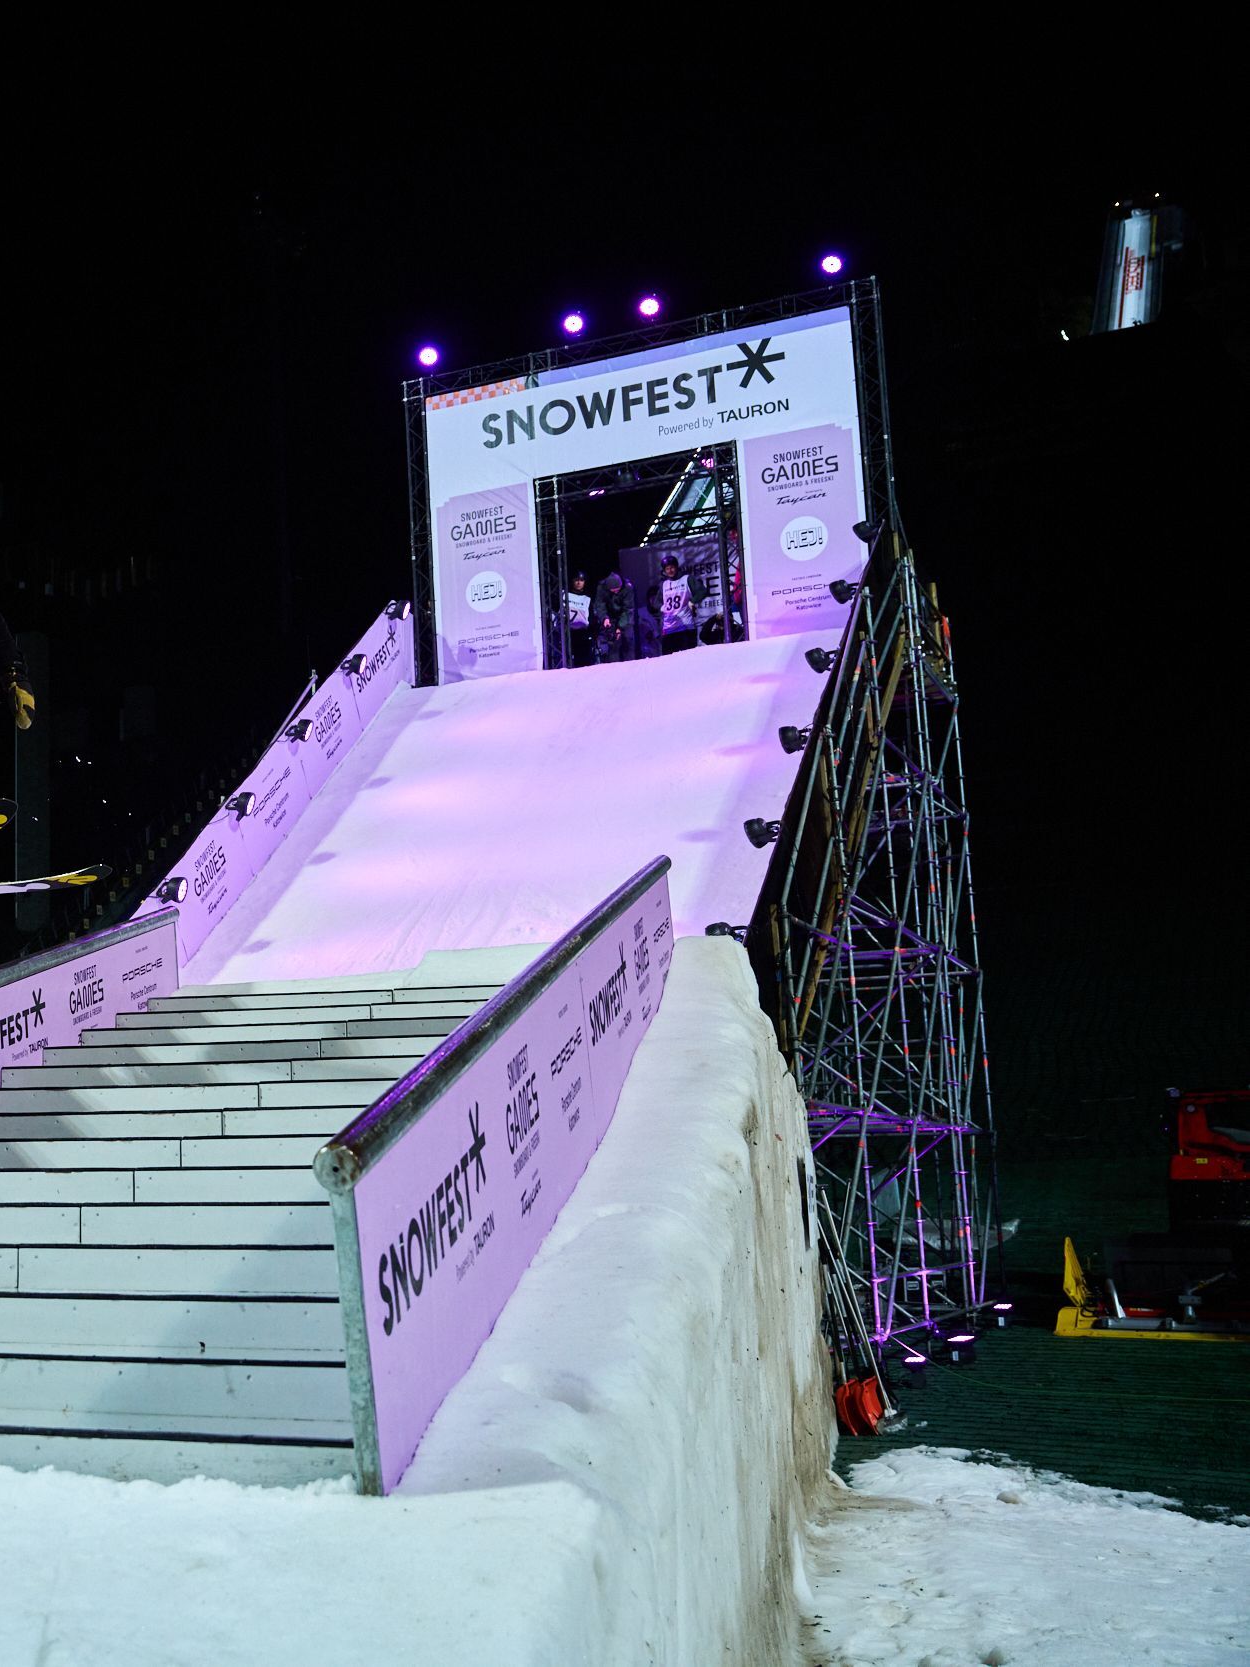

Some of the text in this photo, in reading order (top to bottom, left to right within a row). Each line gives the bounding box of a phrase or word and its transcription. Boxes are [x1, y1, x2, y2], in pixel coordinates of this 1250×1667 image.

[482, 364, 722, 449] SNOWFEST
[658, 398, 789, 437] Powered by TAURON
[773, 445, 824, 464] SNOWFEST
[761, 455, 839, 485] GAMES
[460, 505, 504, 522] SNOWFEST
[776, 492, 827, 506] Taycan
[450, 514, 516, 541] GAMES
[785, 526, 824, 550] HEJ!
[666, 595, 681, 611] 38
[771, 583, 831, 597] PORSCH
[194, 845, 226, 897] GAMES
[122, 957, 163, 984] PORSCHE
[69, 978, 104, 1015] GAMES
[589, 967, 623, 1047] SNOWFEST
[506, 1071, 540, 1155] GAMES
[378, 1152, 472, 1337] SNOWFEST
[473, 1210, 495, 1256] TAURON
